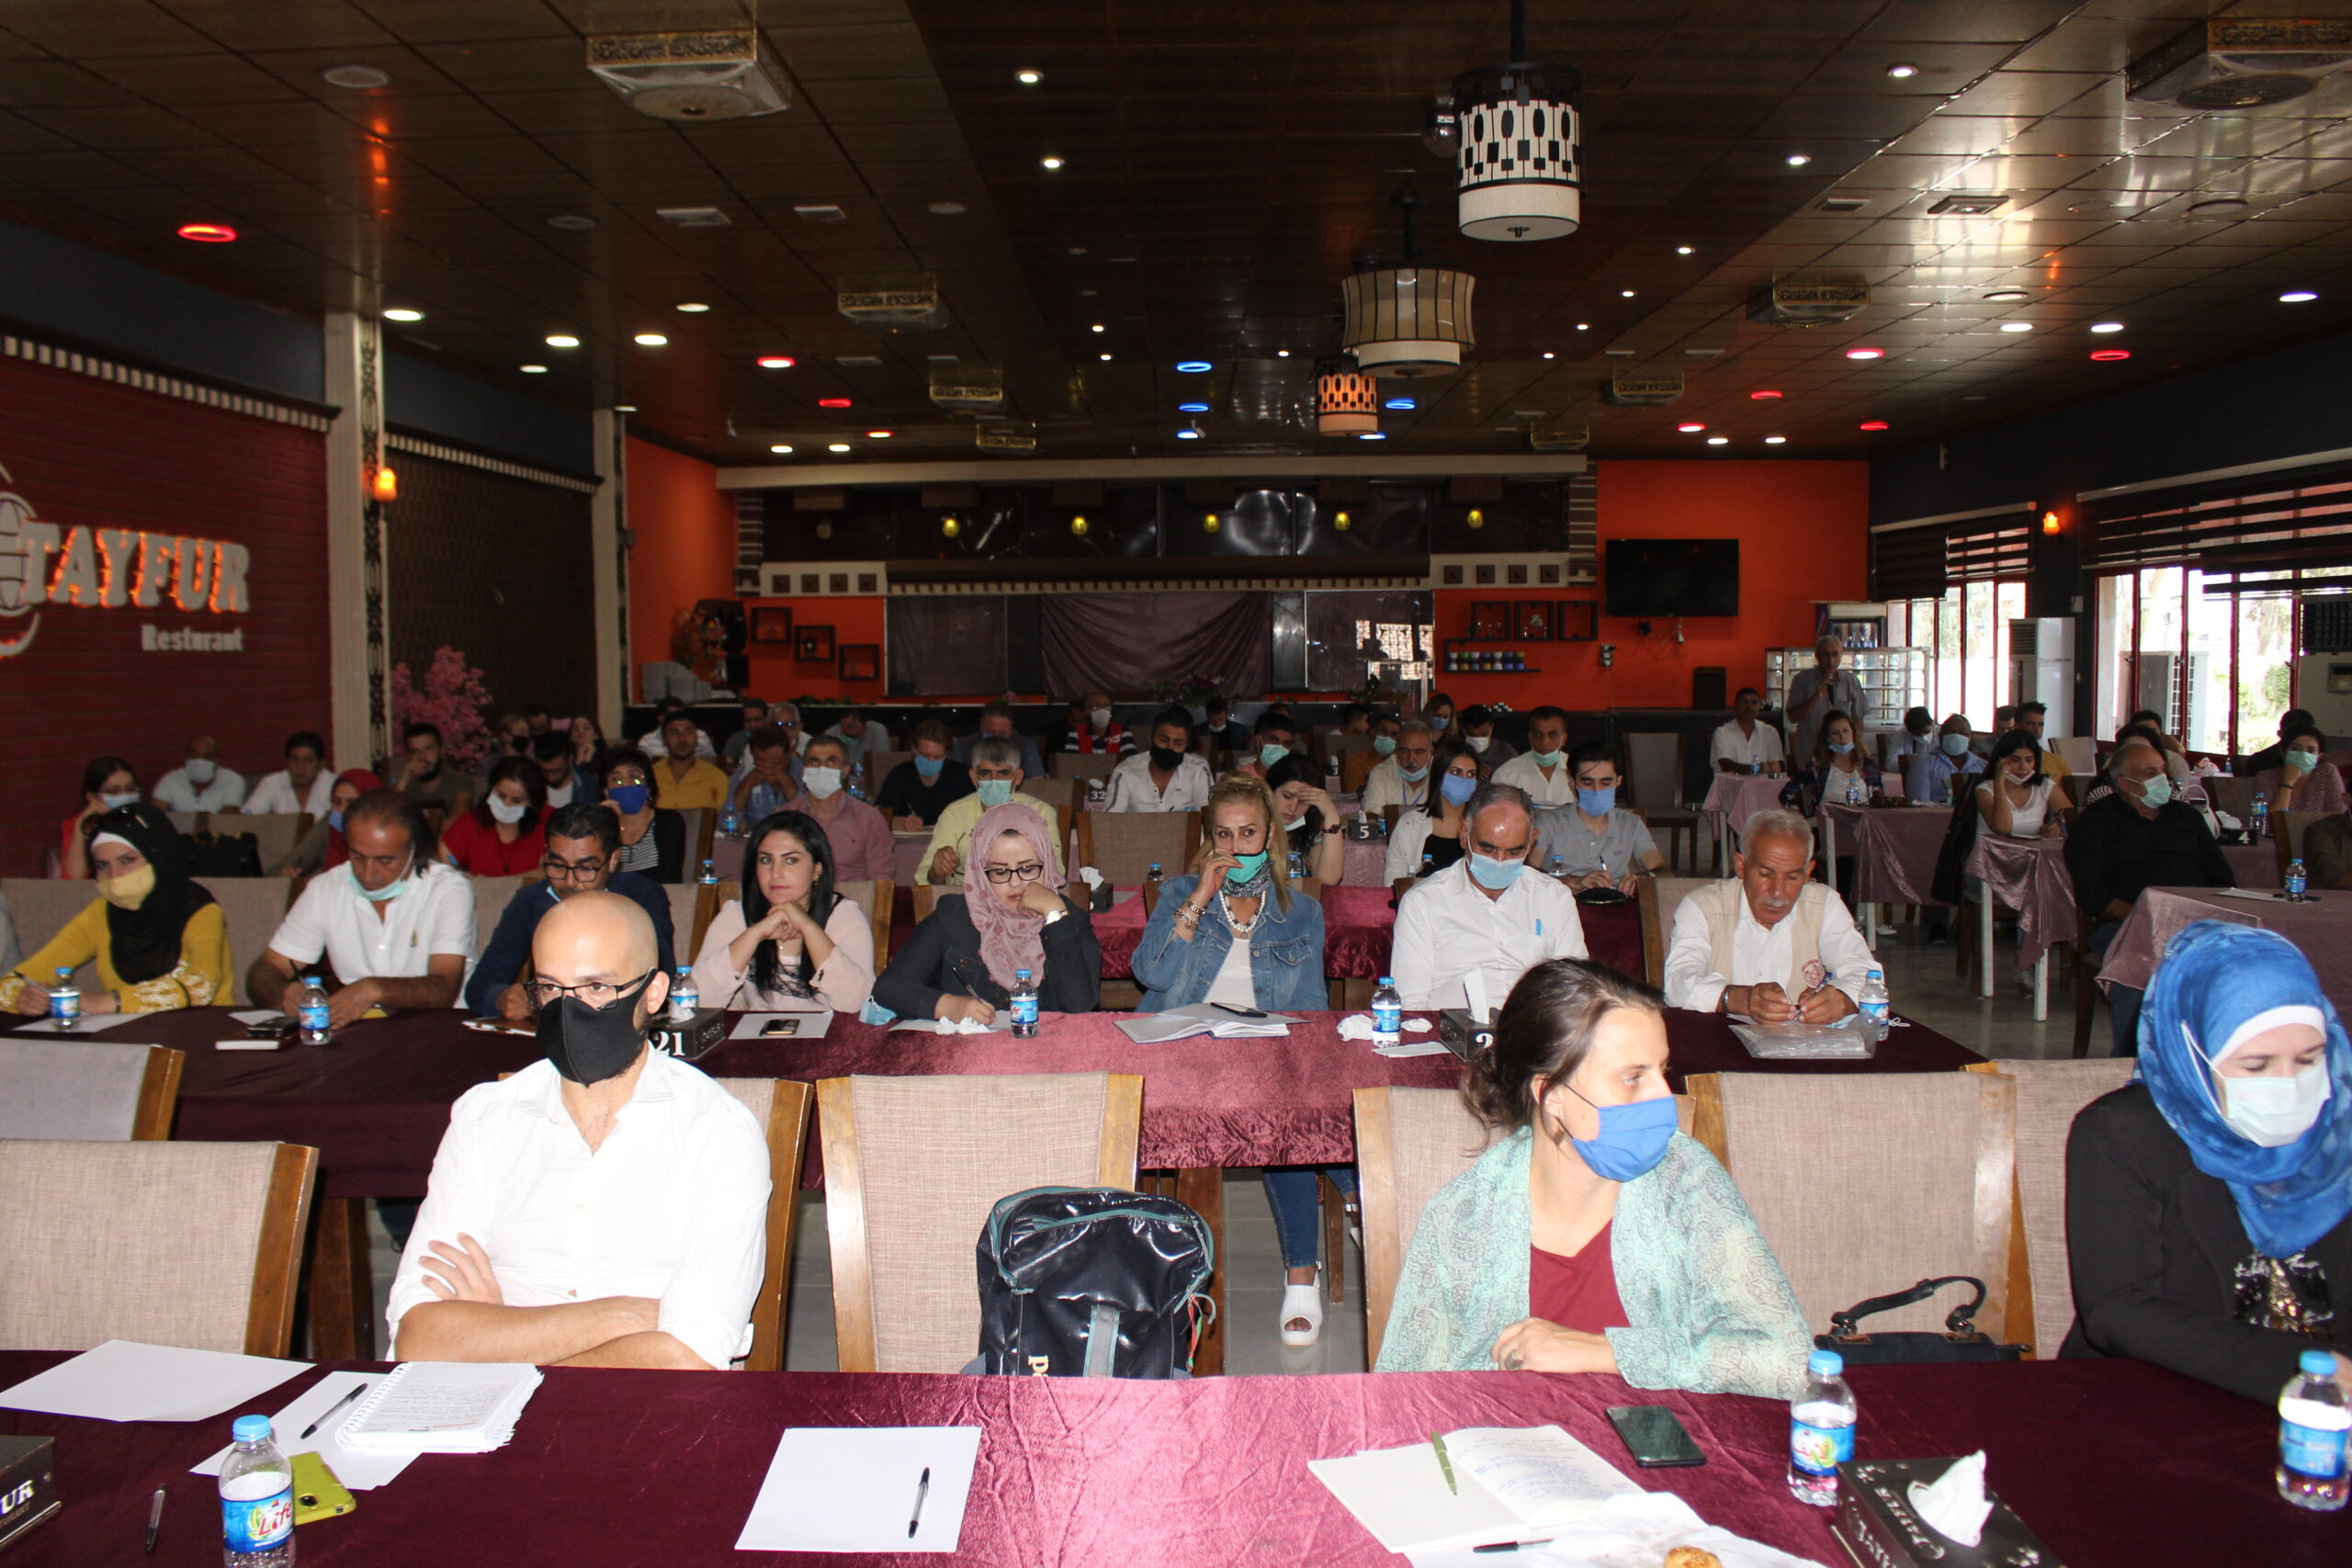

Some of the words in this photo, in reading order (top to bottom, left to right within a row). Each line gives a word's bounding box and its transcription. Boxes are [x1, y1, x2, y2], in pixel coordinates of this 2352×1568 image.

[18, 517, 249, 613] TAYFUR
[1091, 790, 1106, 800] 32
[1359, 825, 1370, 839] 5
[2238, 830, 2250, 844] 4
[653, 1031, 685, 1055] 21
